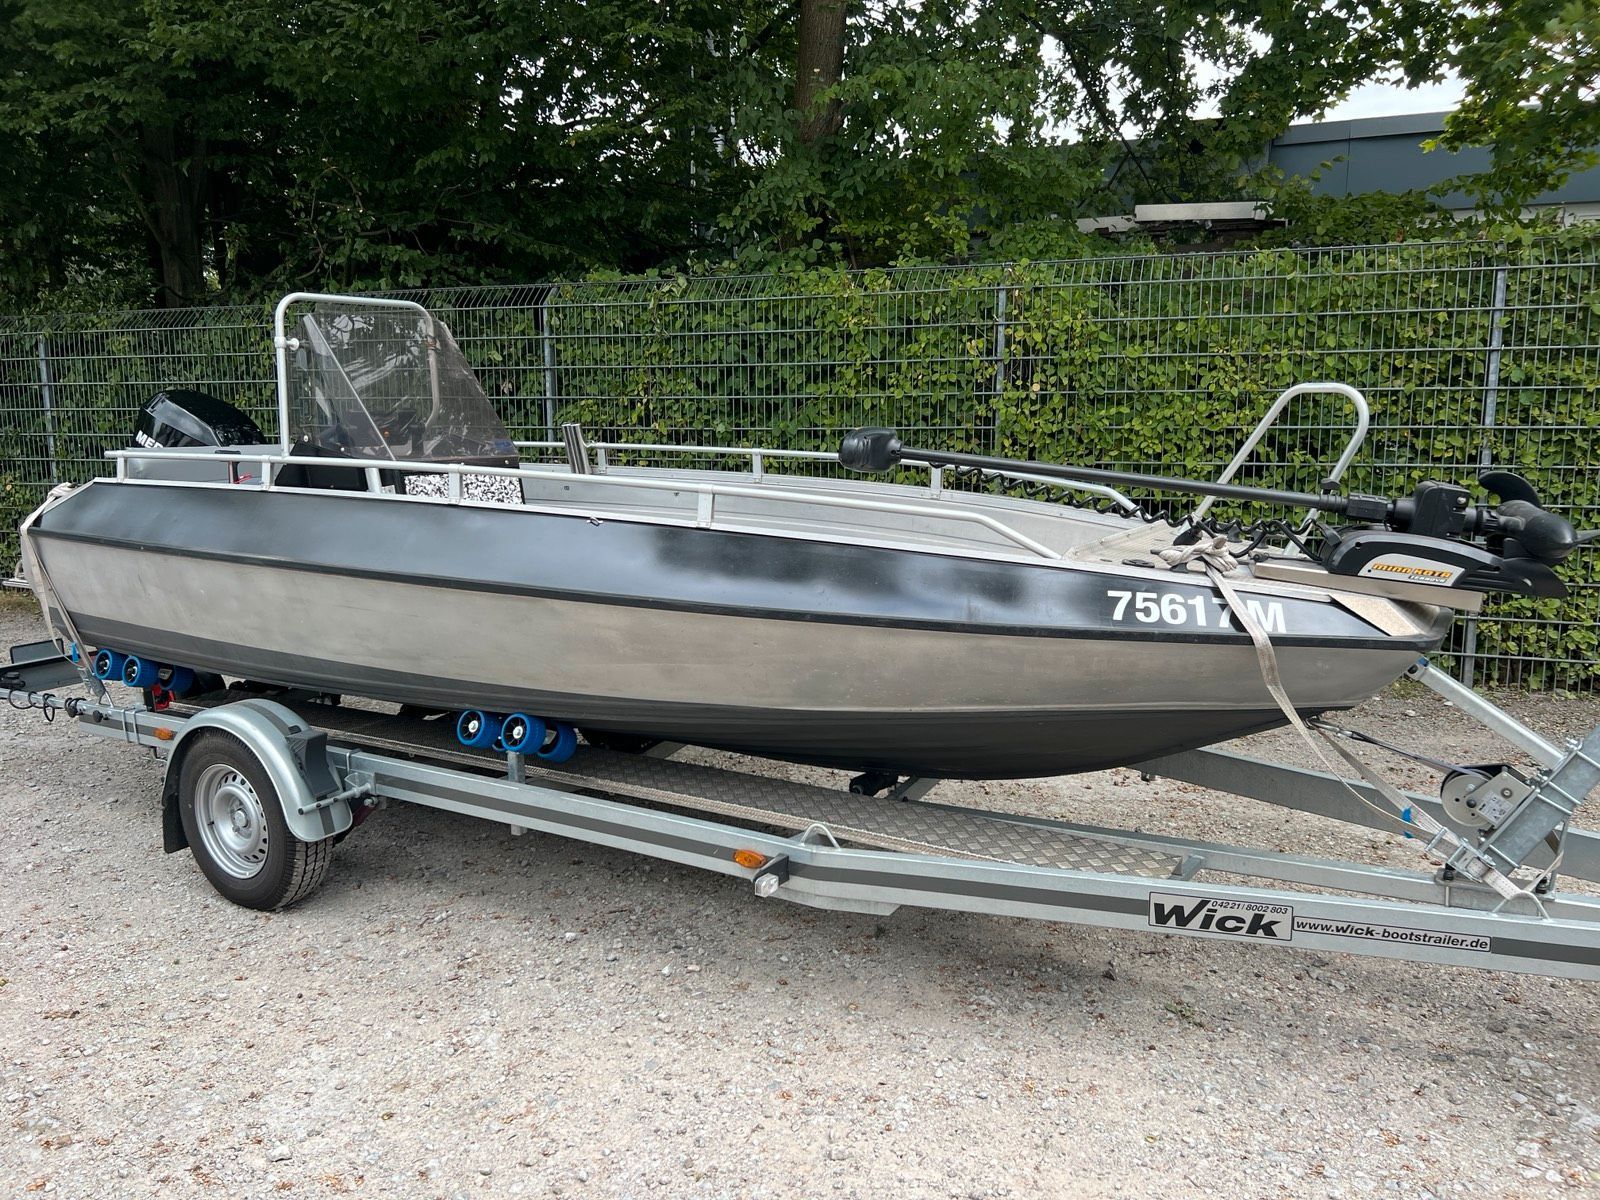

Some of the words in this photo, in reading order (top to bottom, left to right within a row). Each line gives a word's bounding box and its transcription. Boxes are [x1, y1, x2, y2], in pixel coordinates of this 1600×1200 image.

[1107, 590, 1234, 628] 75617
[1246, 600, 1287, 633] M
[1153, 899, 1282, 938] Wick
